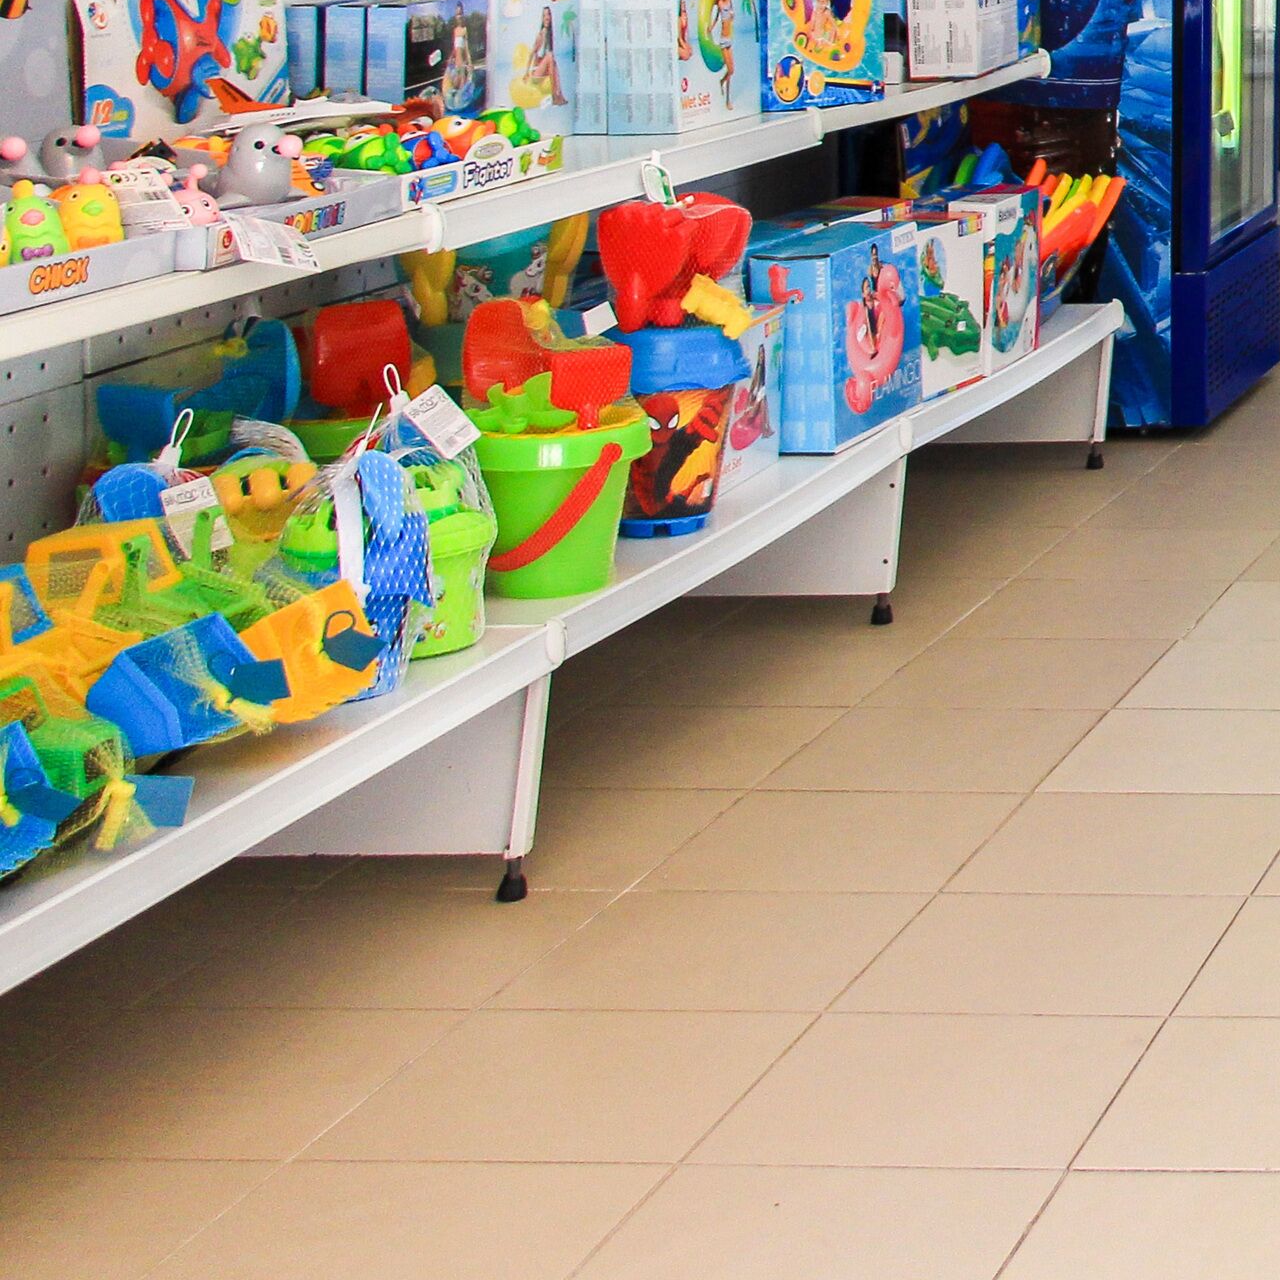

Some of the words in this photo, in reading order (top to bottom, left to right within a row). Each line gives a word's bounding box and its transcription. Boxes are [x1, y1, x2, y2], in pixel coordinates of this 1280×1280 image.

[681, 96, 697, 110] Wet
[699, 93, 711, 107] Set
[463, 157, 514, 188] Fighter
[29, 256, 90, 295] CHICK
[870, 359, 921, 402] FLAMINGO
